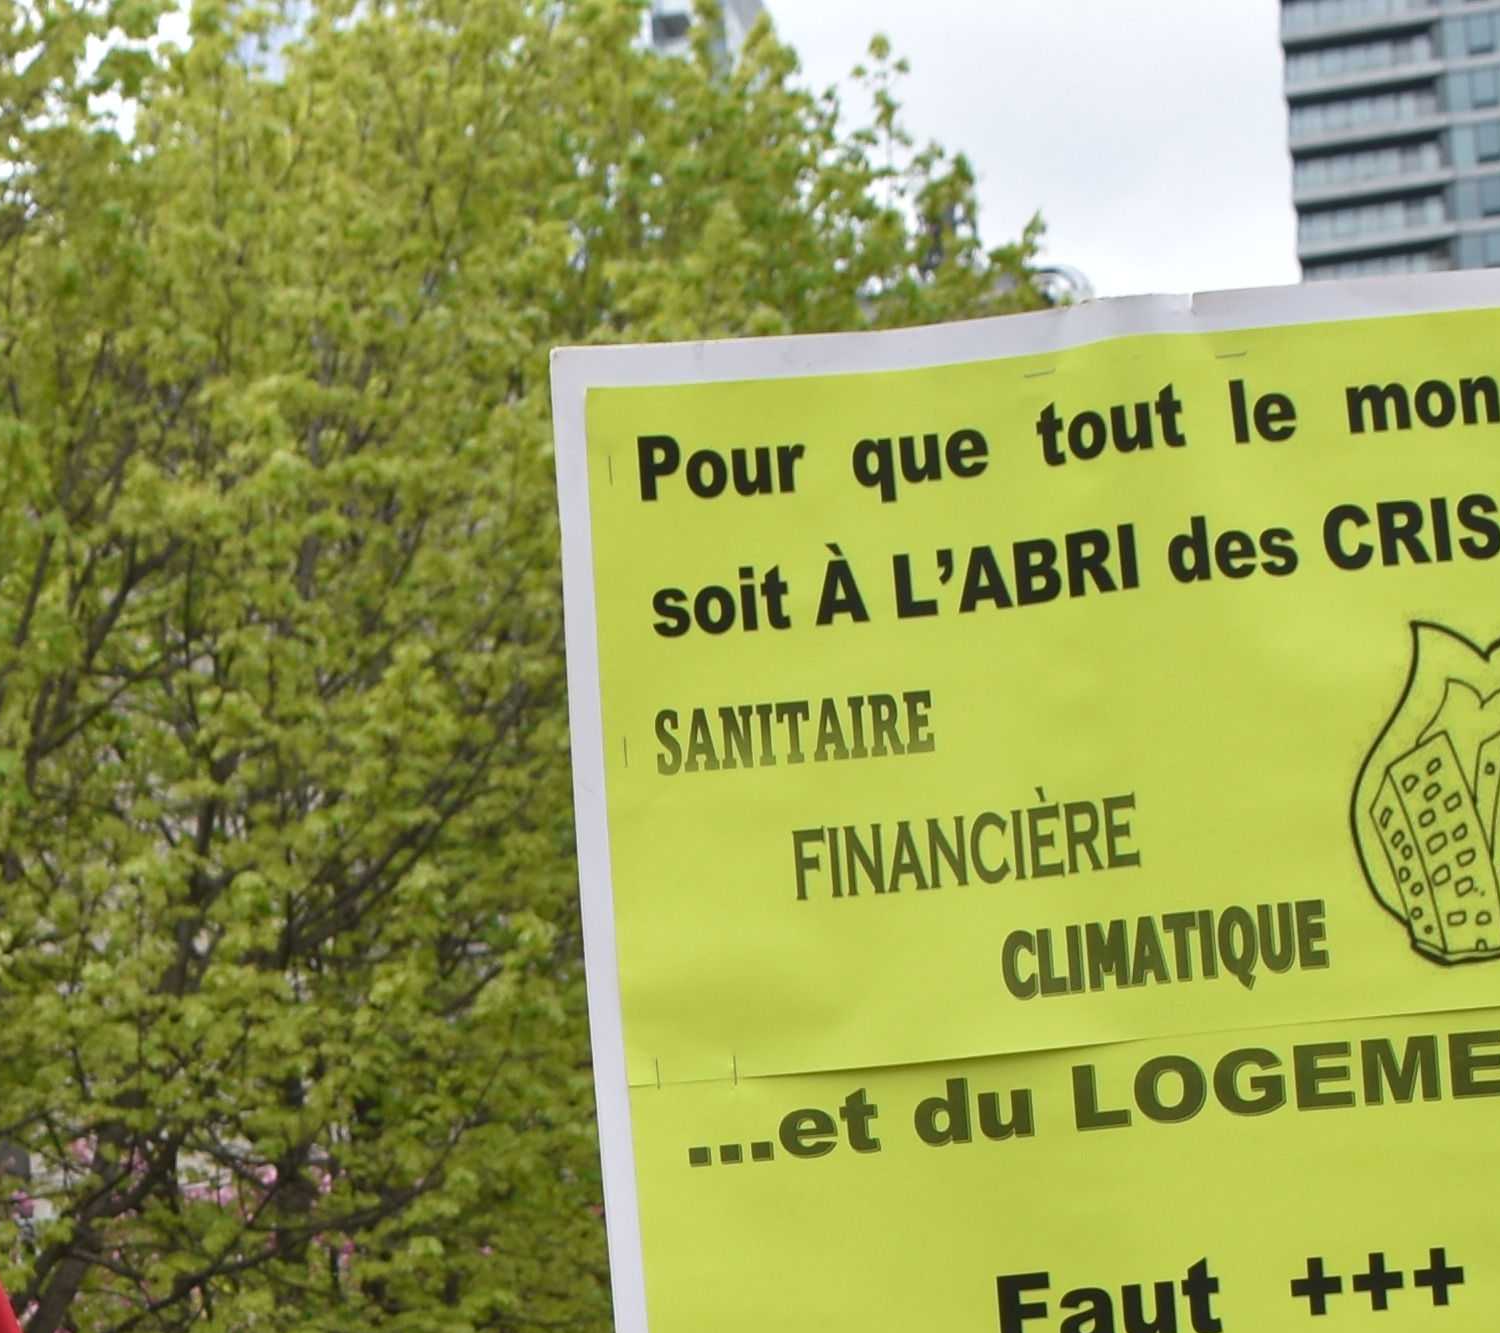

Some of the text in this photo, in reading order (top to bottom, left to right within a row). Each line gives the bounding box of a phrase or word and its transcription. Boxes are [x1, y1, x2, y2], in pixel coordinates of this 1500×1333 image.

[636, 434, 805, 502] Pour
[851, 428, 990, 503] que
[1036, 381, 1187, 467] tout
[1229, 379, 1297, 444] le
[651, 566, 792, 638] soit
[814, 542, 869, 627] À
[1167, 515, 1298, 584] des
[653, 690, 936, 777] SANITAIRE
[792, 786, 1142, 902] FINANCIÈRE
[1000, 899, 1331, 1001] CLIMATIQUE
[687, 1089, 881, 1166] ...et
[912, 1077, 1035, 1148] du
